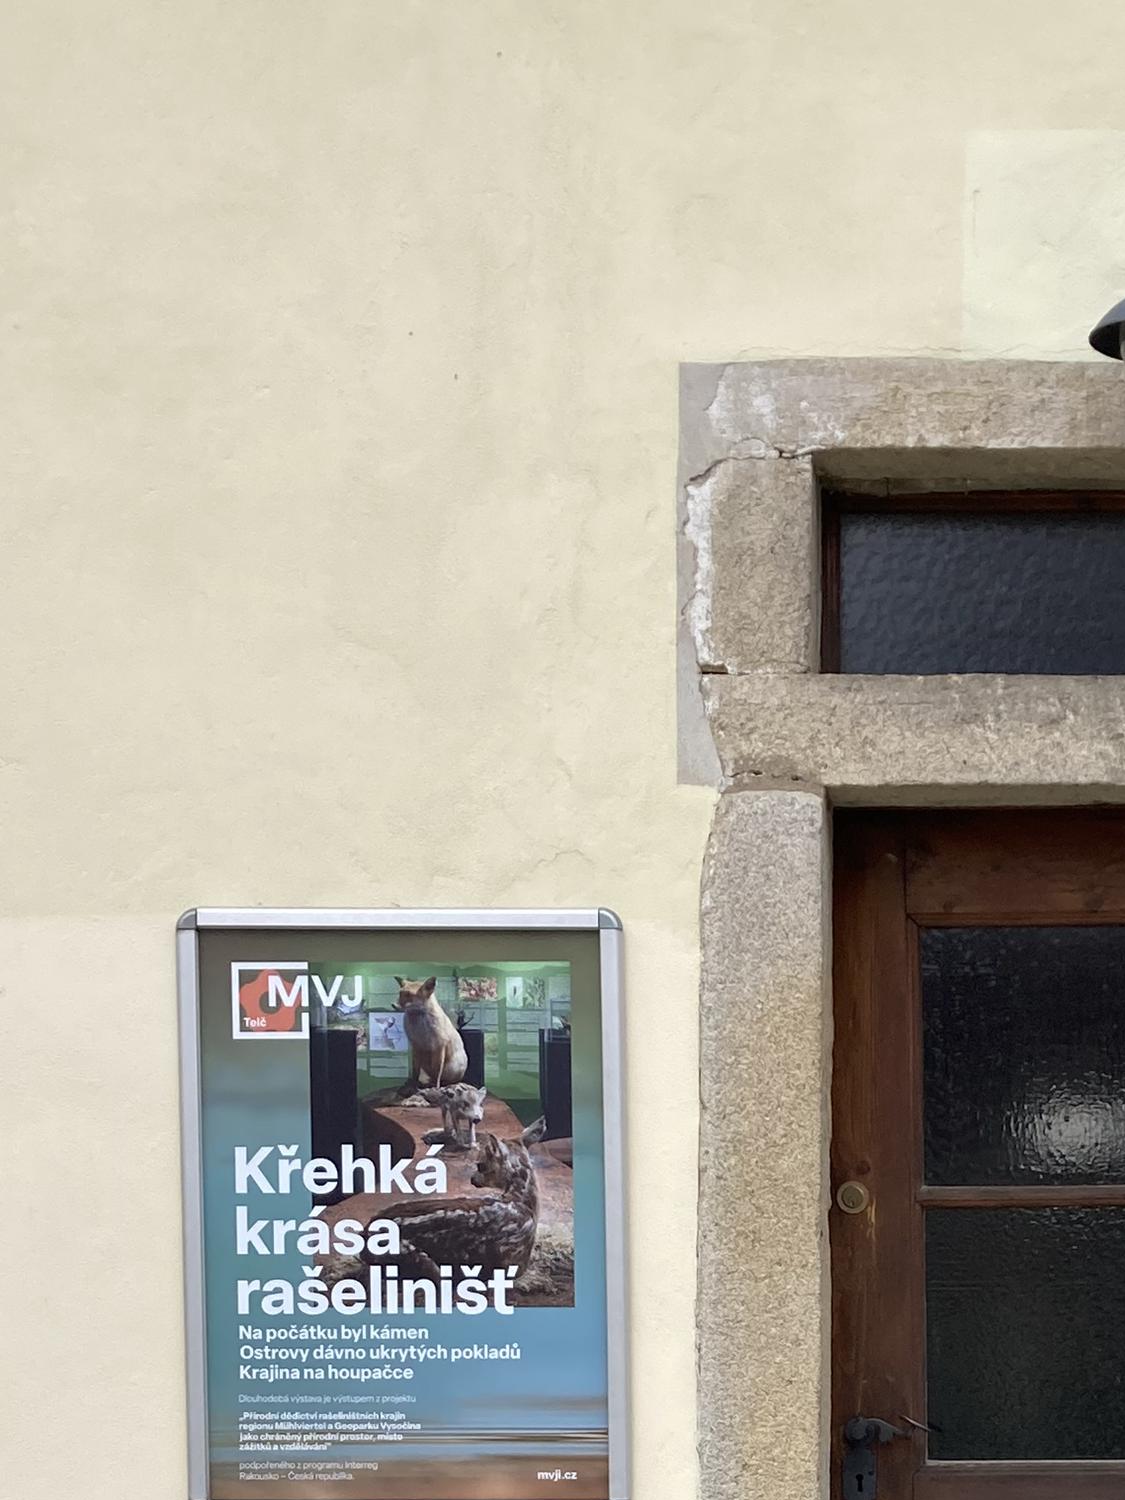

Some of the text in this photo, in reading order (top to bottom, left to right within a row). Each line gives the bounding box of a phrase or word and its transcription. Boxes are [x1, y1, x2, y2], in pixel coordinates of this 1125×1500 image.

[268, 975, 362, 1008] MVJ
[243, 1016, 267, 1028] Telč
[234, 1144, 448, 1195] Křehká
[235, 1205, 401, 1256] krása
[236, 1265, 519, 1316] rašelinišť
[238, 1324, 430, 1343] Na počátku byl kámen
[239, 1342, 521, 1363] Ostrovy dávno ukrytých pokladů
[239, 1364, 414, 1383] Krajina na houpačce
[322, 1394, 331, 1404] je
[381, 1394, 417, 1404] projektu
[280, 1411, 318, 1420] dědictví
[379, 1411, 406, 1421] krajin
[239, 1422, 274, 1431] regionu
[334, 1422, 379, 1431] Geoparku
[380, 1421, 422, 1431] Vysočina
[239, 1432, 259, 1442] jako
[259, 1432, 302, 1442] chráněný
[303, 1432, 339, 1442] přírodní
[339, 1432, 376, 1442] prostor,
[239, 1461, 296, 1471] podpořeného
[302, 1462, 344, 1471] programu
[344, 1461, 379, 1471] Interreg
[239, 1471, 280, 1481] Rakousko
[287, 1470, 315, 1481] Česká
[536, 1468, 578, 1482] mvji.cz
